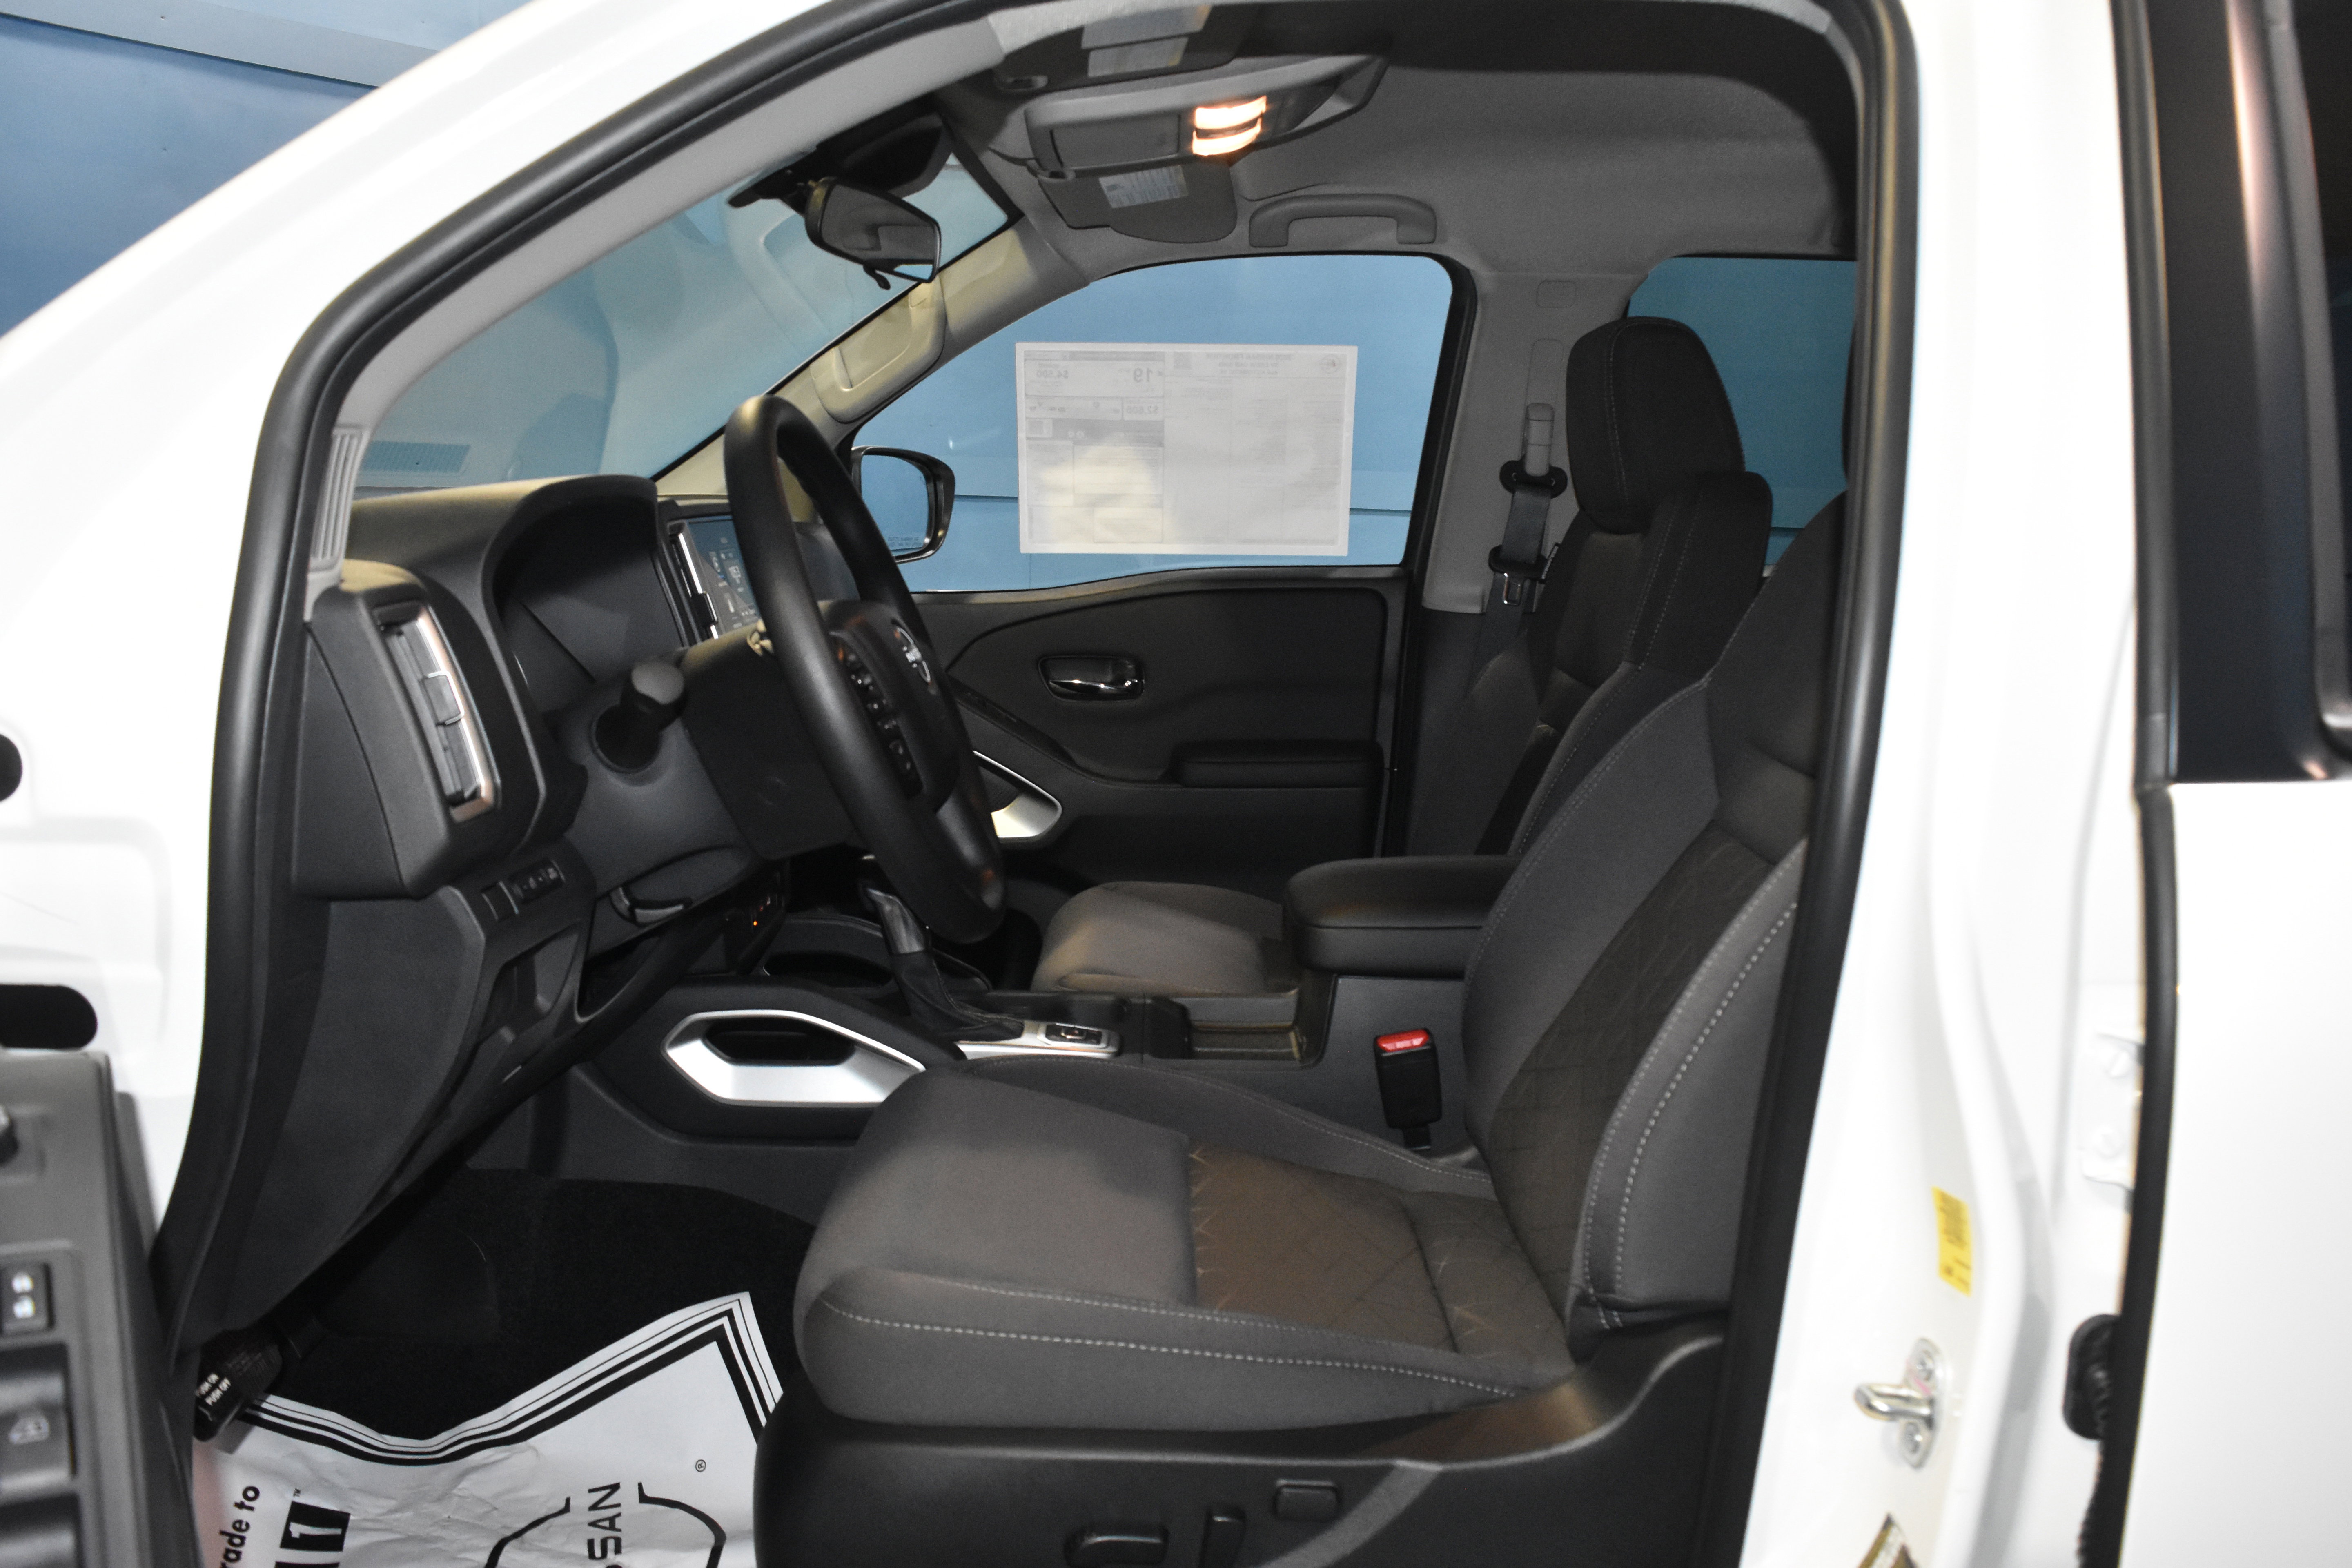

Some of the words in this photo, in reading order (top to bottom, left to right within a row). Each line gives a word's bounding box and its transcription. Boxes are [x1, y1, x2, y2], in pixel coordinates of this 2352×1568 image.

[207, 1373, 219, 1384] ON
[205, 1388, 223, 1406] PUSH
[219, 1377, 231, 1391] OFF
[234, 1486, 260, 1511] to
